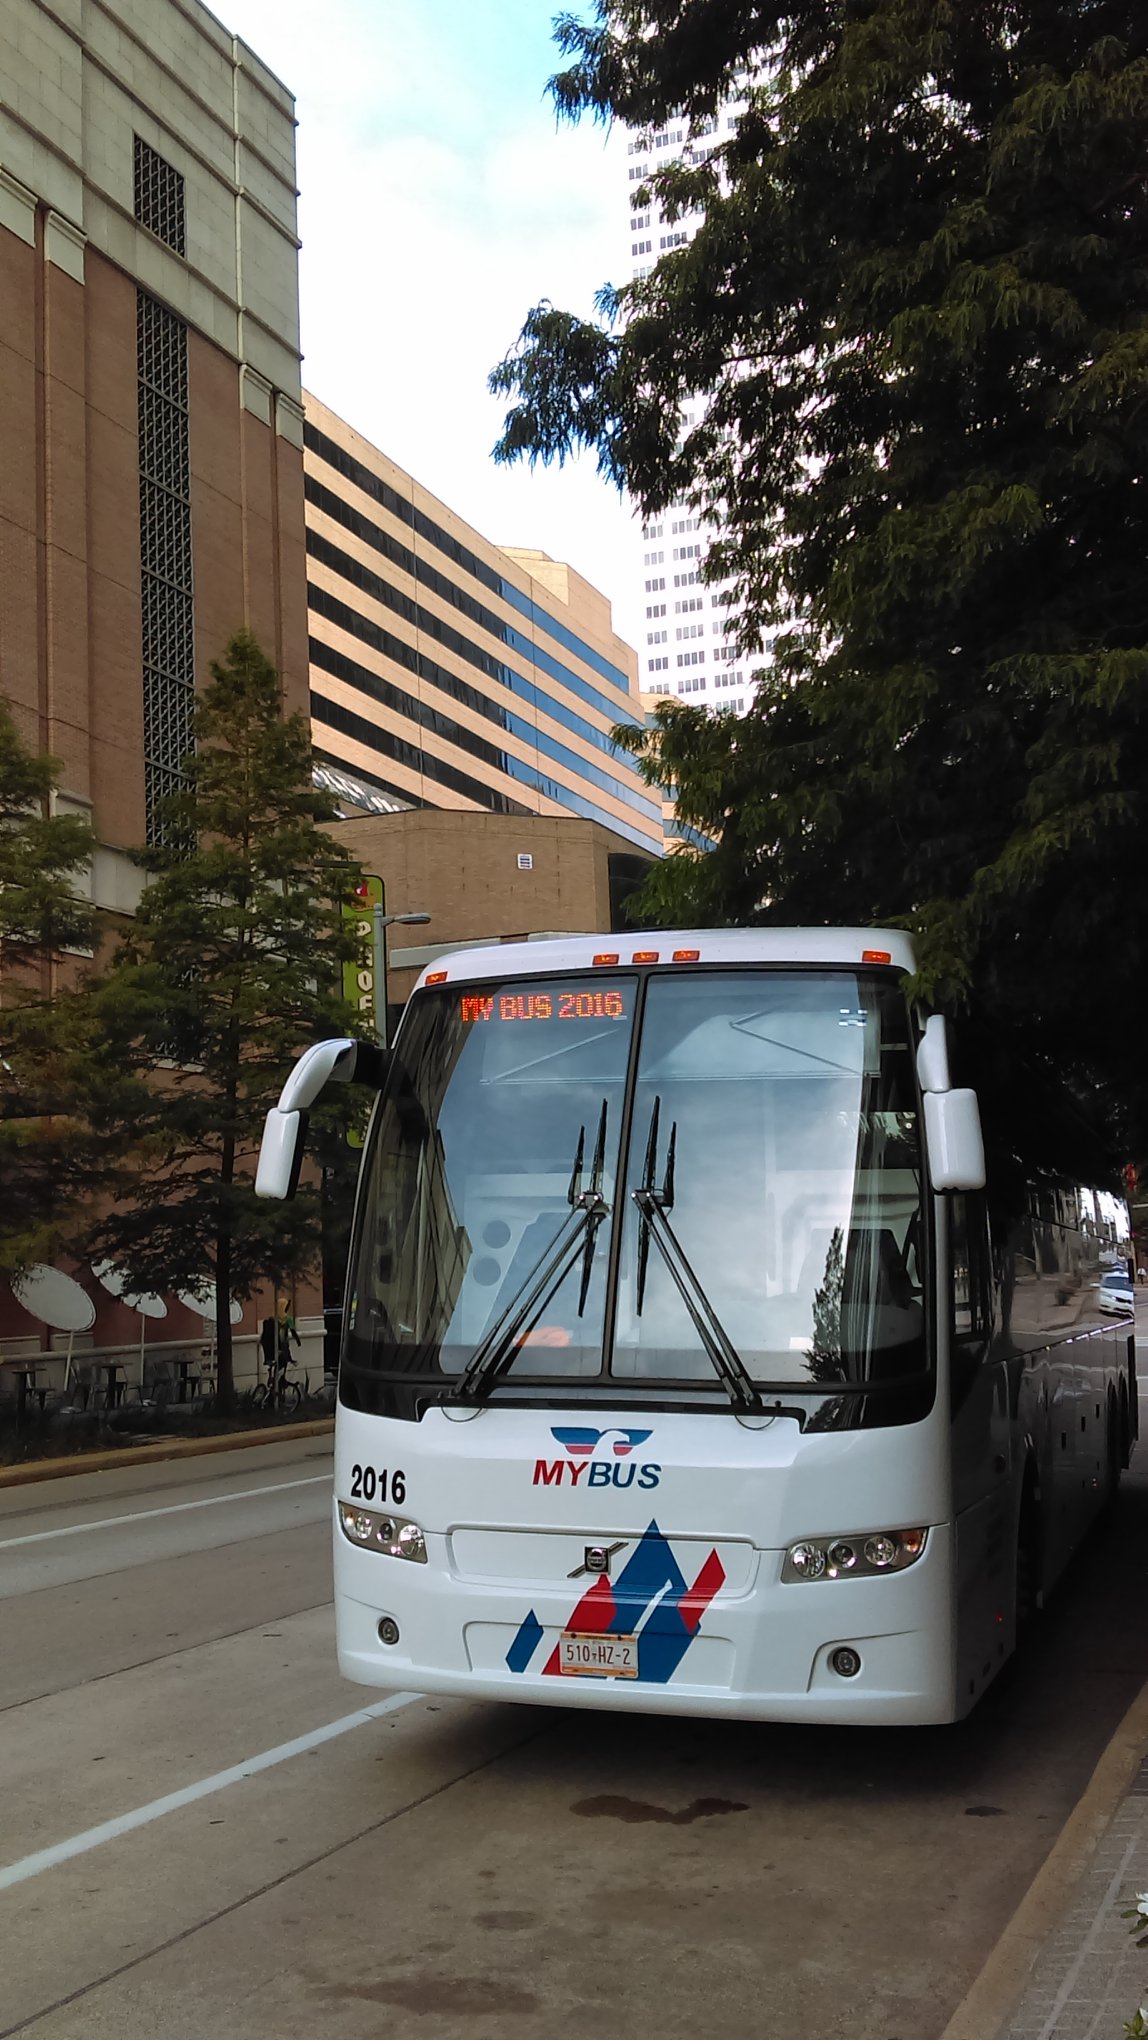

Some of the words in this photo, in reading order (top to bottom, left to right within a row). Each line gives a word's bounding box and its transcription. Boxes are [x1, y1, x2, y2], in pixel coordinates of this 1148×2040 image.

[461, 997, 494, 1022] MY
[500, 995, 552, 1020] BUS
[558, 992, 623, 1017] 2016
[351, 1464, 406, 1505] 2016
[532, 1459, 662, 1489] MYBUS
[566, 1644, 631, 1665] 510-HZ-2
